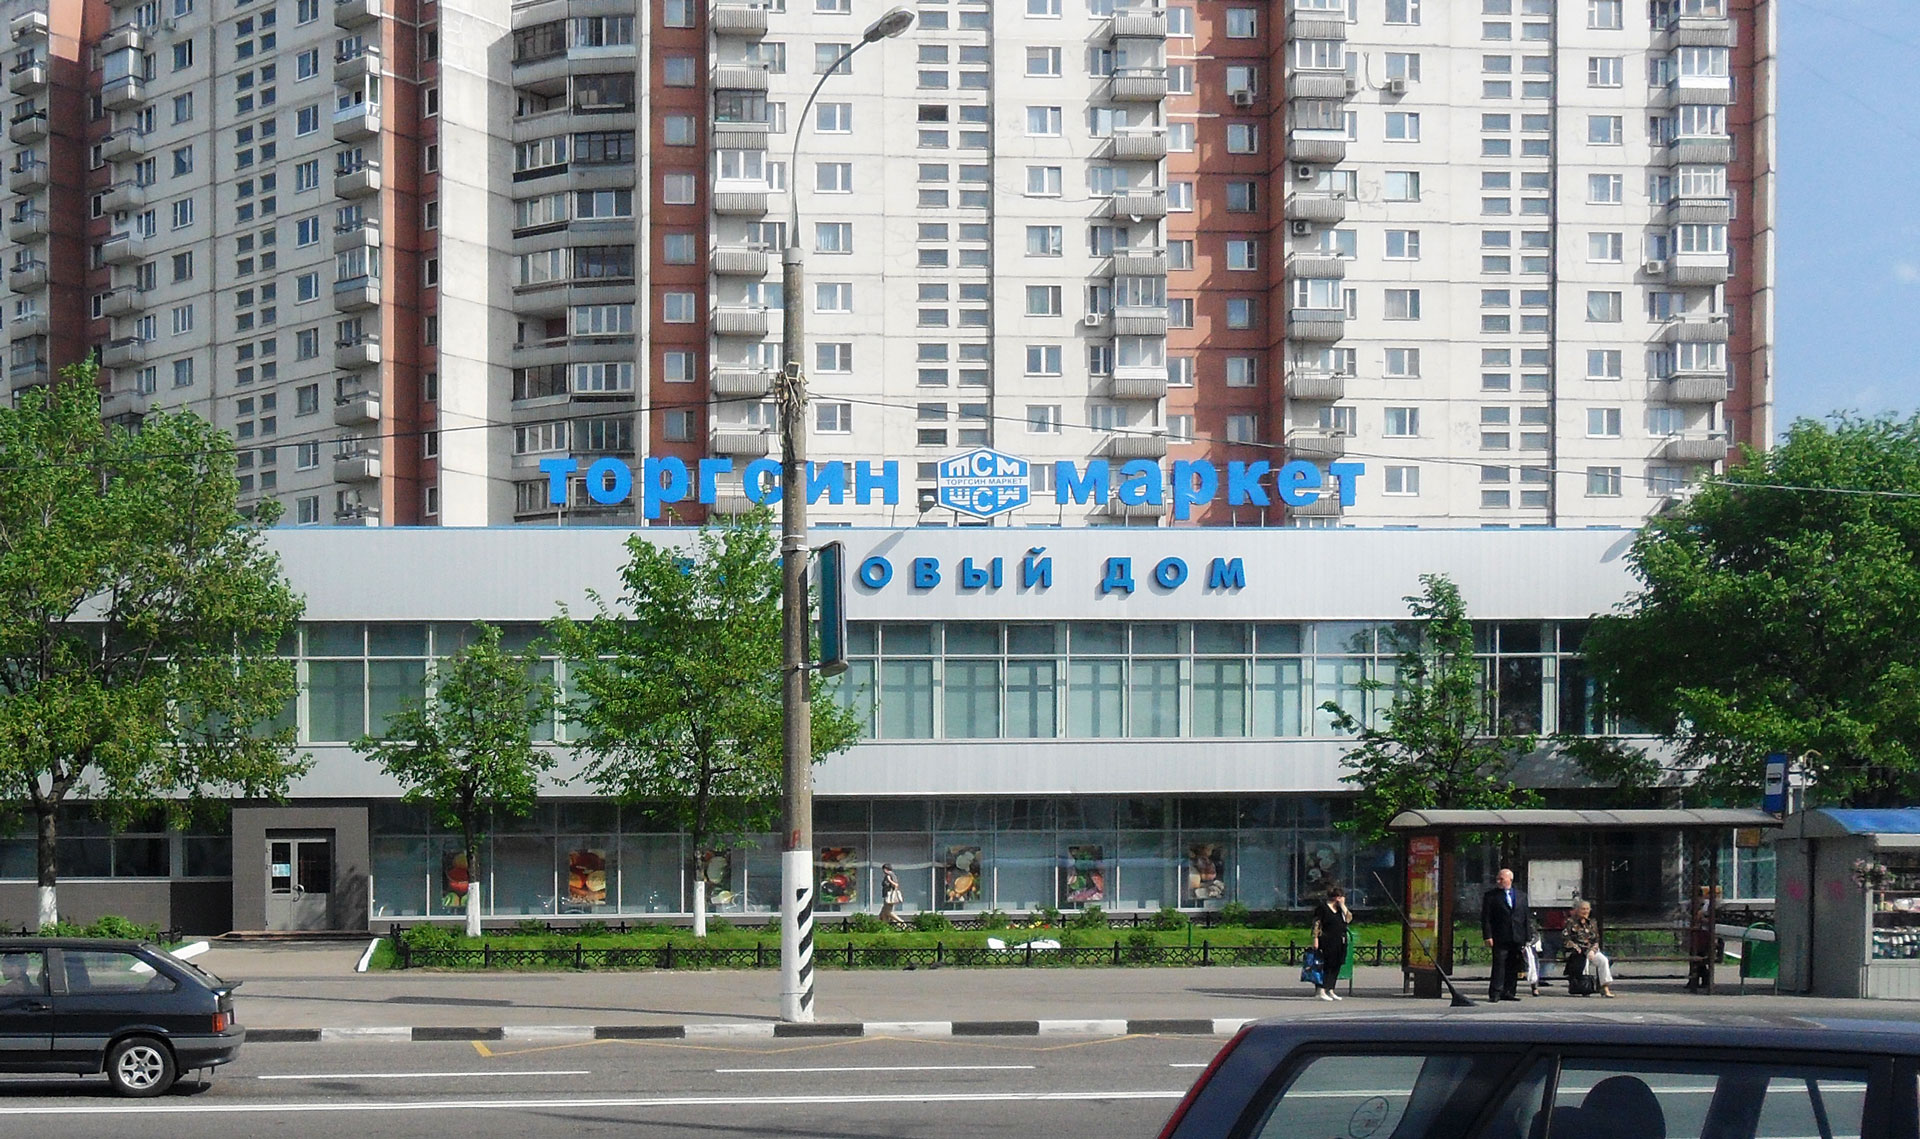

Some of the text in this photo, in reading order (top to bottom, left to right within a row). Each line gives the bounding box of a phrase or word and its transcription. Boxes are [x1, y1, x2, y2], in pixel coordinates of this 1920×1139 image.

[540, 456, 1365, 520] торгсин маркет
[946, 477, 1023, 486] ТОРГСИН МАРКЕТ
[1103, 557, 1247, 593] дом
